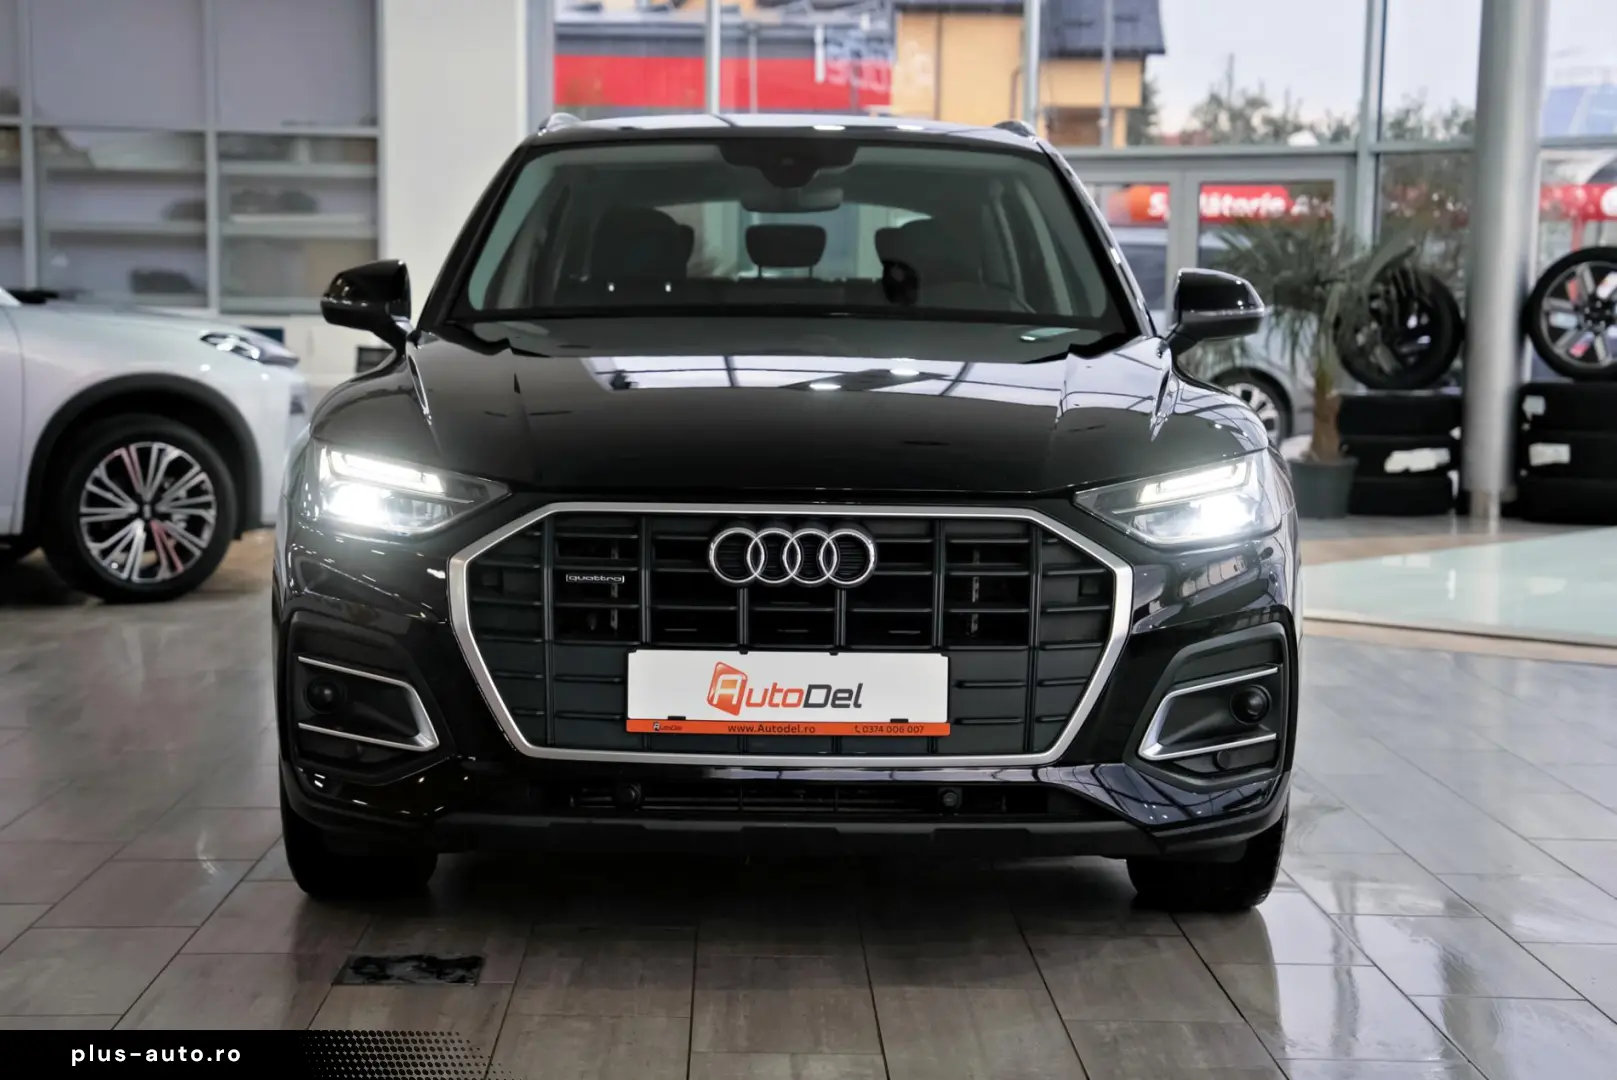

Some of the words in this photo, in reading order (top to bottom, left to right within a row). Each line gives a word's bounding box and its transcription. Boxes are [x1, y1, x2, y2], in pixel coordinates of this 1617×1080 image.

[709, 667, 863, 713] AutoDel
[727, 723, 816, 734] www.Autodel.ro
[862, 725, 884, 733] 0374
[907, 725, 925, 734] 007
